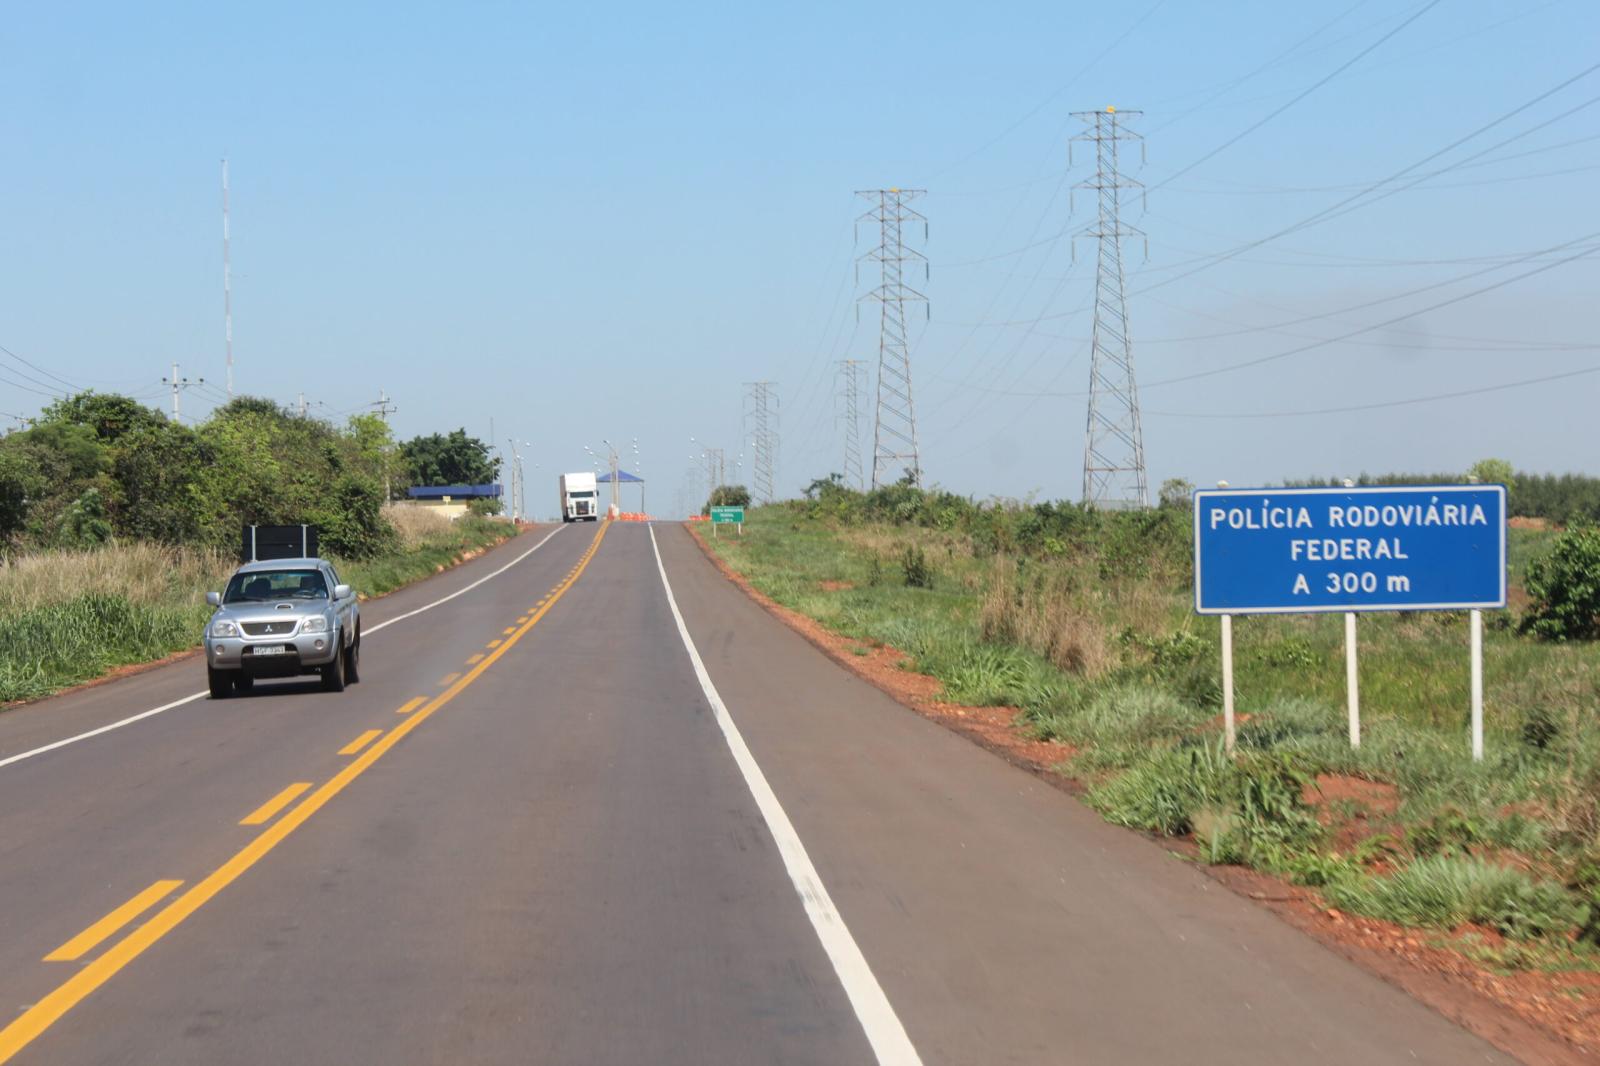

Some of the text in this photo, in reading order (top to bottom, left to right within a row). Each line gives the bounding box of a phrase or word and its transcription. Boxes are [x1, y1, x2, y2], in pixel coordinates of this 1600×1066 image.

[1210, 496, 1488, 530] POLÍCIA RODOVIÁRIA
[1291, 538, 1408, 561] FEDERAL
[1292, 572, 1410, 594] A 300 m
